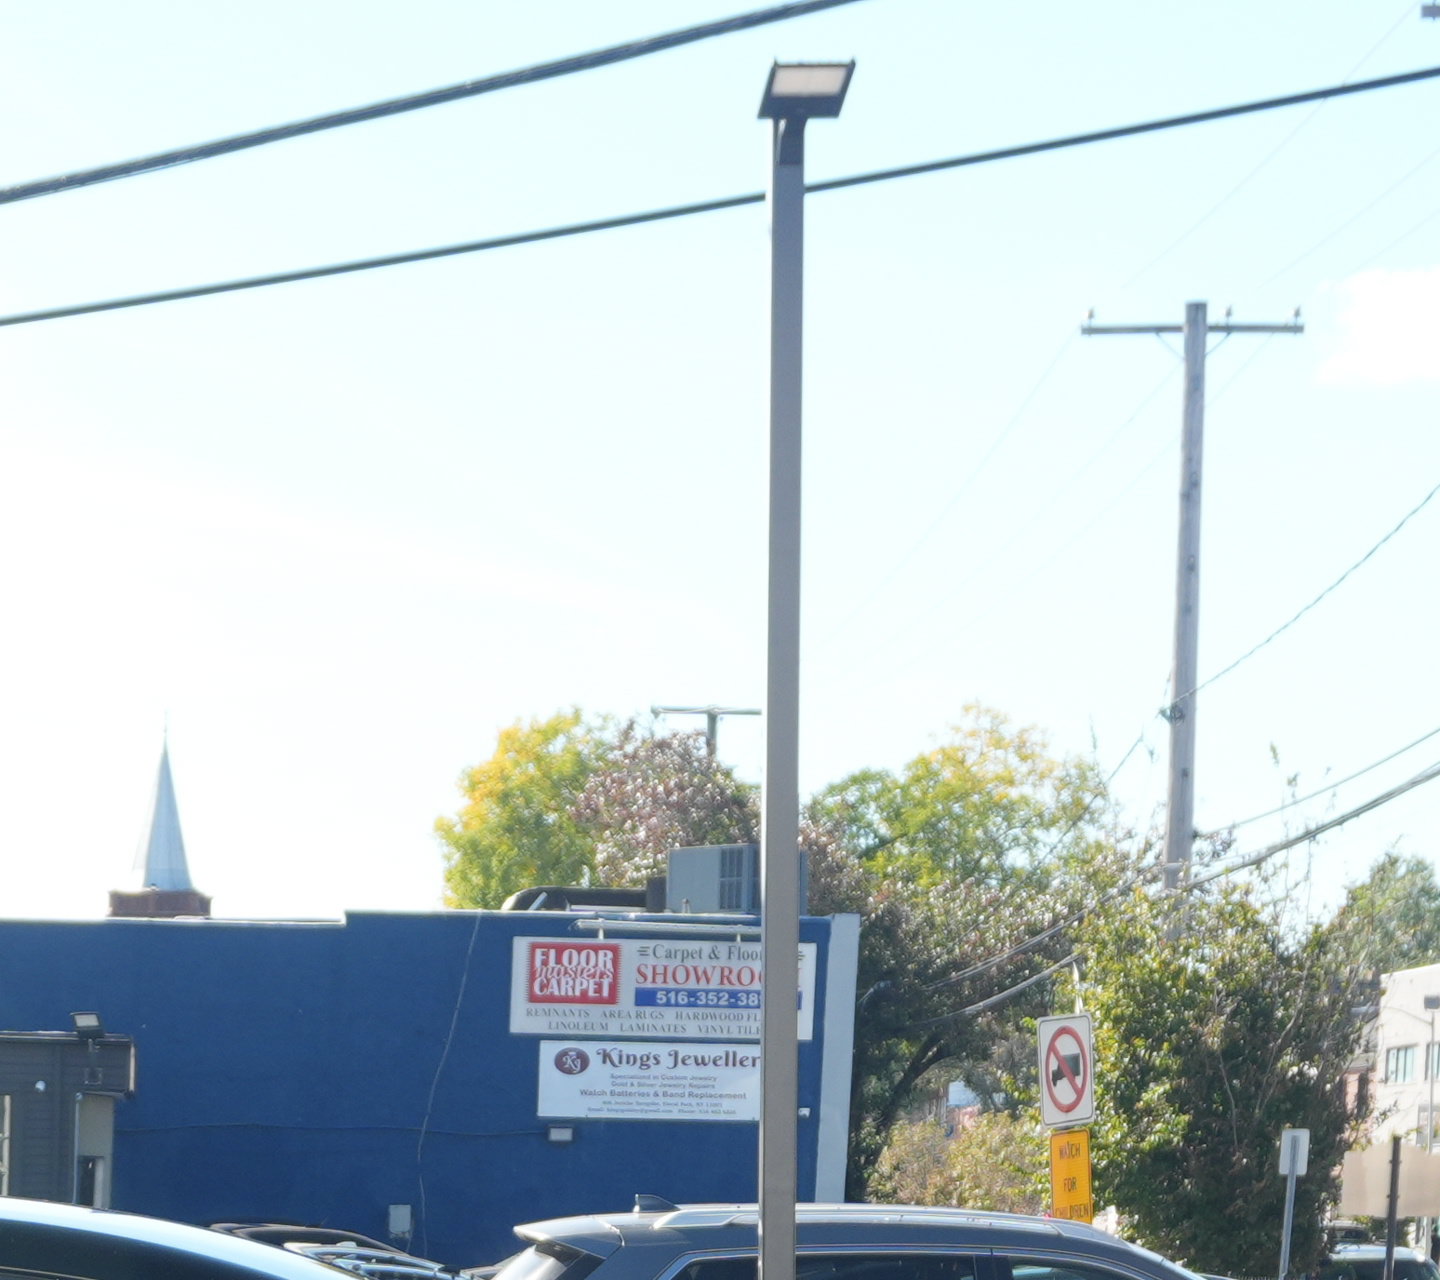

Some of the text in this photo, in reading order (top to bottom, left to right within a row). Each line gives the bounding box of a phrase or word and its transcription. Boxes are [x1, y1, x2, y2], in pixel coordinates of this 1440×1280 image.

[534, 948, 614, 971] FLOOR
[653, 943, 703, 963] Carpet
[708, 946, 720, 960] &
[635, 963, 762, 986] SHOWRO
[533, 977, 611, 997] CARPET
[656, 990, 761, 1007] 516-352-38
[526, 1007, 591, 1017] REMNANTS
[601, 1009, 632, 1019] AREA
[635, 1010, 664, 1020] RUGS
[675, 1010, 744, 1021] HARDWOOD
[548, 1020, 609, 1031] LINOLEUM
[620, 1022, 687, 1033] LAMINATES
[697, 1024, 734, 1034] VINYL
[596, 1047, 660, 1069] Kings
[579, 1089, 607, 1097] Watch
[610, 1089, 651, 1097] Batteries
[662, 1090, 686, 1098] Band
[688, 1091, 747, 1100] Replacement
[1059, 1142, 1081, 1160] WATCH
[1063, 1176, 1077, 1192] FOR
